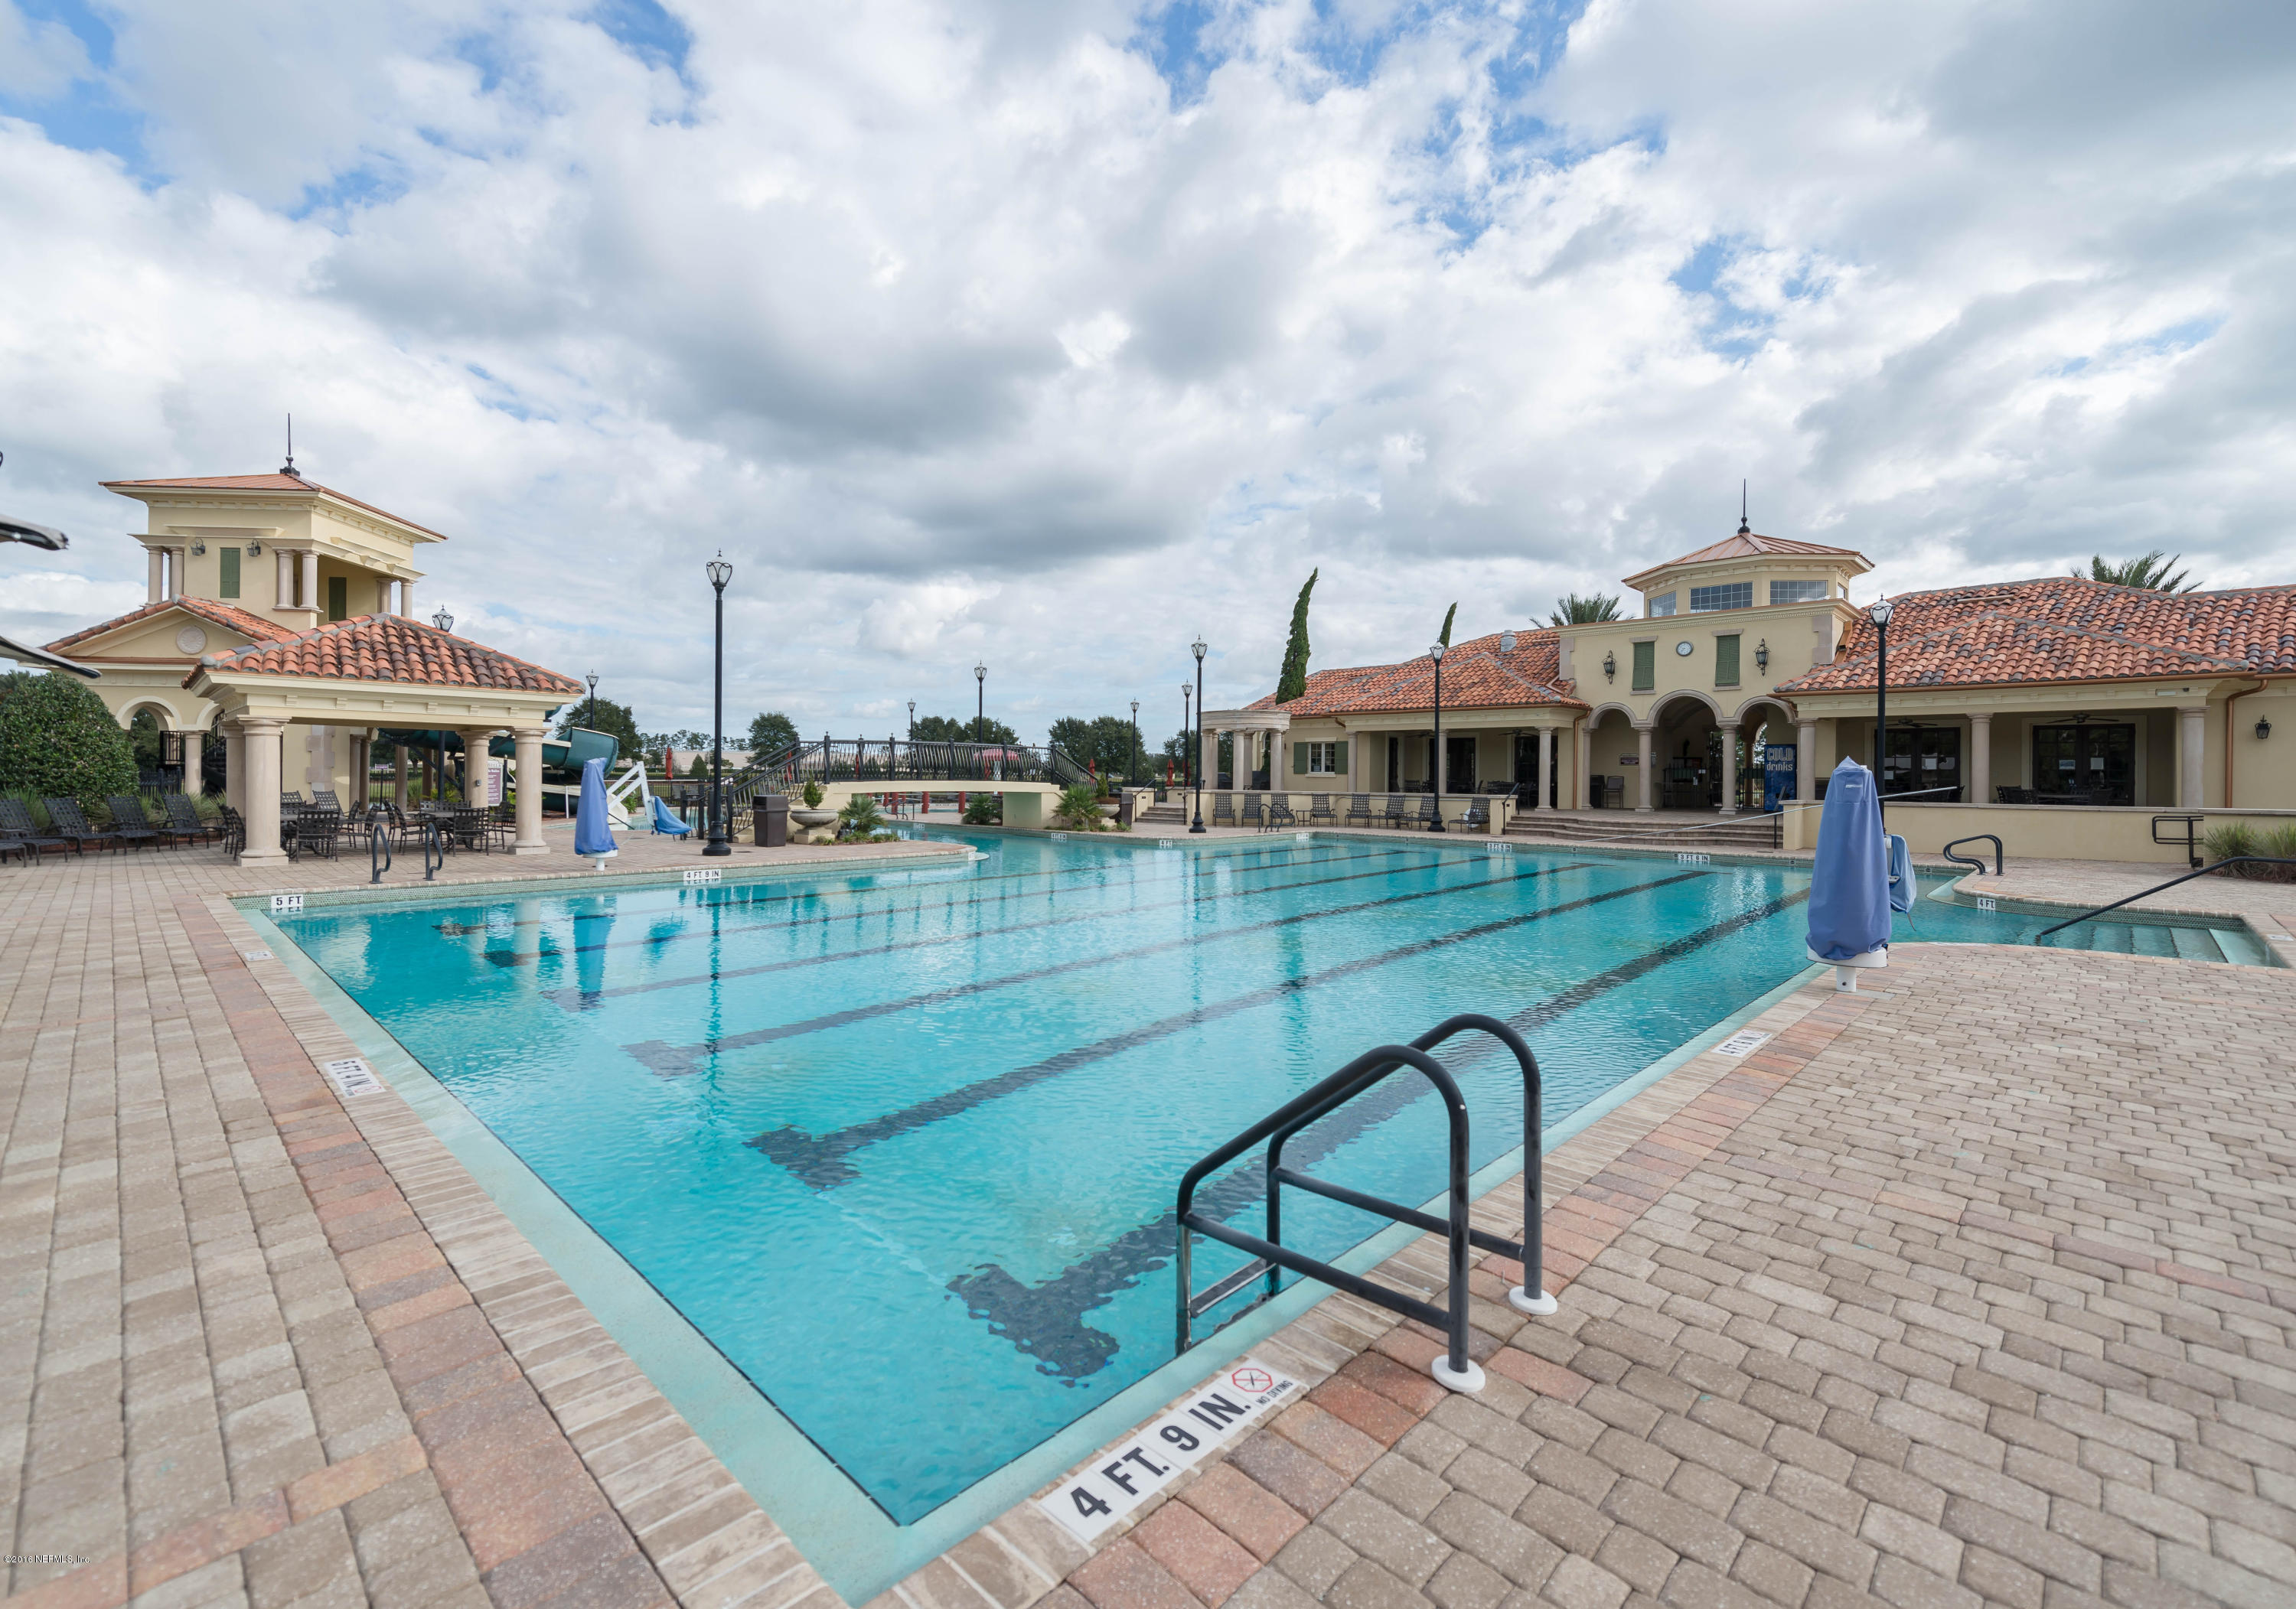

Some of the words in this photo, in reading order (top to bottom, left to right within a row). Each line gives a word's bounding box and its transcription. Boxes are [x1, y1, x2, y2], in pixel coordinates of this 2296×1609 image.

[1766, 748, 1793, 761] COLD
[1766, 761, 1793, 772] drinks
[276, 897, 283, 906] 5
[1979, 899, 1984, 907] 4
[1255, 1396, 1270, 1405] NO
[1267, 1380, 1293, 1399] DIVING
[1070, 1487, 1113, 1517] 4
[1101, 1447, 1170, 1496] FT.
[1159, 1425, 1200, 1451] 9
[1188, 1393, 1251, 1431] IN.
